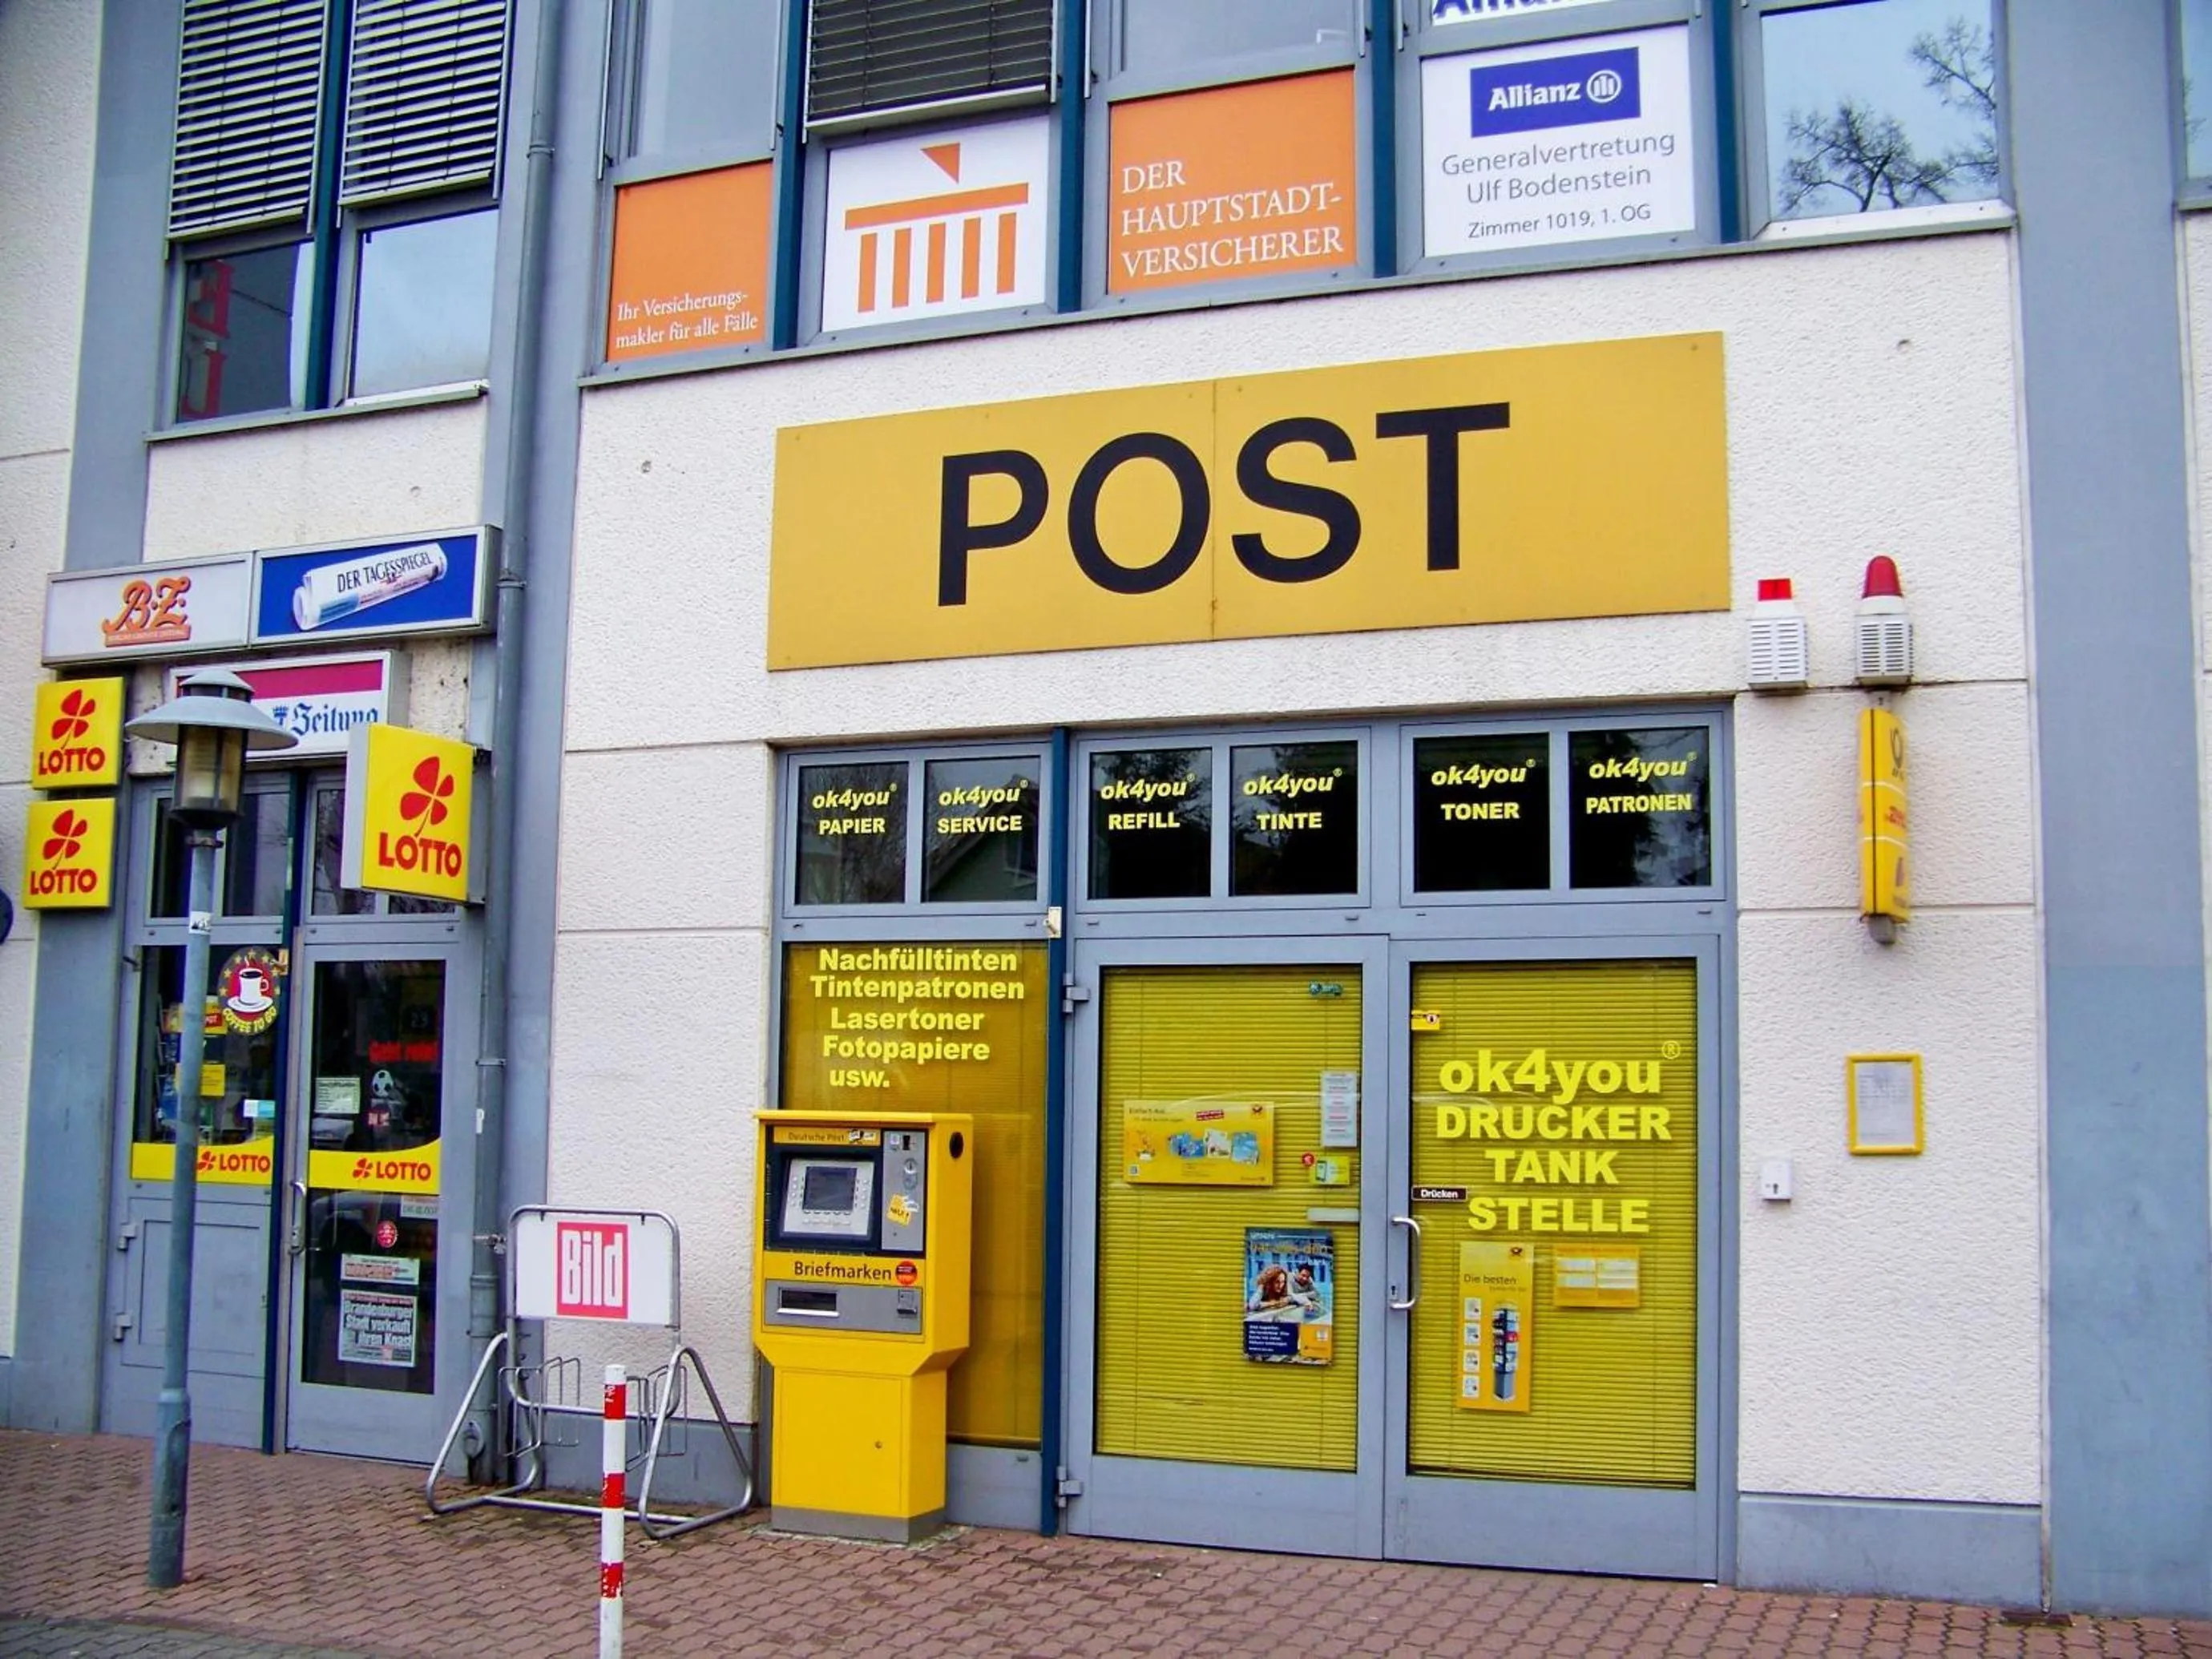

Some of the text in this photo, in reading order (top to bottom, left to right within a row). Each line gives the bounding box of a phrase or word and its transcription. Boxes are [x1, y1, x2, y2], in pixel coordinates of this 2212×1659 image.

[1488, 82, 1581, 111] Allianz
[1443, 134, 1675, 175] Generalvertretung
[1122, 160, 1185, 195] DER
[1467, 166, 1651, 204] Ulf Bodenstein
[1122, 182, 1342, 236] HAUPTSTADT-
[1468, 217, 1540, 239] Zimmer
[1548, 211, 1595, 231] 1019,
[1621, 204, 1651, 221] OG
[1122, 226, 1343, 279] VERSICHERER
[618, 290, 749, 321] Ihr Versicherungs-
[616, 311, 759, 349] makler für alle Fälle
[938, 401, 1511, 607] POST
[337, 551, 434, 593] DER TAGESSPIEGEL
[38, 746, 106, 775] LOTTO
[1441, 803, 1520, 821] TONER
[1586, 794, 1692, 814] PATRONEN
[819, 817, 886, 835] PAPIER
[937, 815, 1022, 834] SERVICE
[1108, 812, 1180, 831] REFILL
[1257, 813, 1322, 830] TINTE
[378, 832, 463, 878] LOTTO
[30, 867, 98, 895] LOTTO
[819, 948, 1018, 972] Nachfülltinten
[809, 975, 1025, 1003] Tintenpatronen
[223, 1007, 252, 1033] COFFEE
[830, 1007, 984, 1031] Lasertoner
[822, 1035, 991, 1064] Fotopapiere
[830, 1069, 890, 1088] usw.
[1436, 1105, 1673, 1140] DRUCKER
[219, 1154, 271, 1173] LOTTO
[376, 1161, 432, 1181] LOTTO
[1484, 1149, 1619, 1185] TANK
[1421, 1189, 1459, 1198] Drücken
[1468, 1197, 1649, 1233] STELLE
[562, 1229, 624, 1308] Bild
[794, 1261, 891, 1280] Briefmarken
[1463, 1274, 1481, 1282] Die
